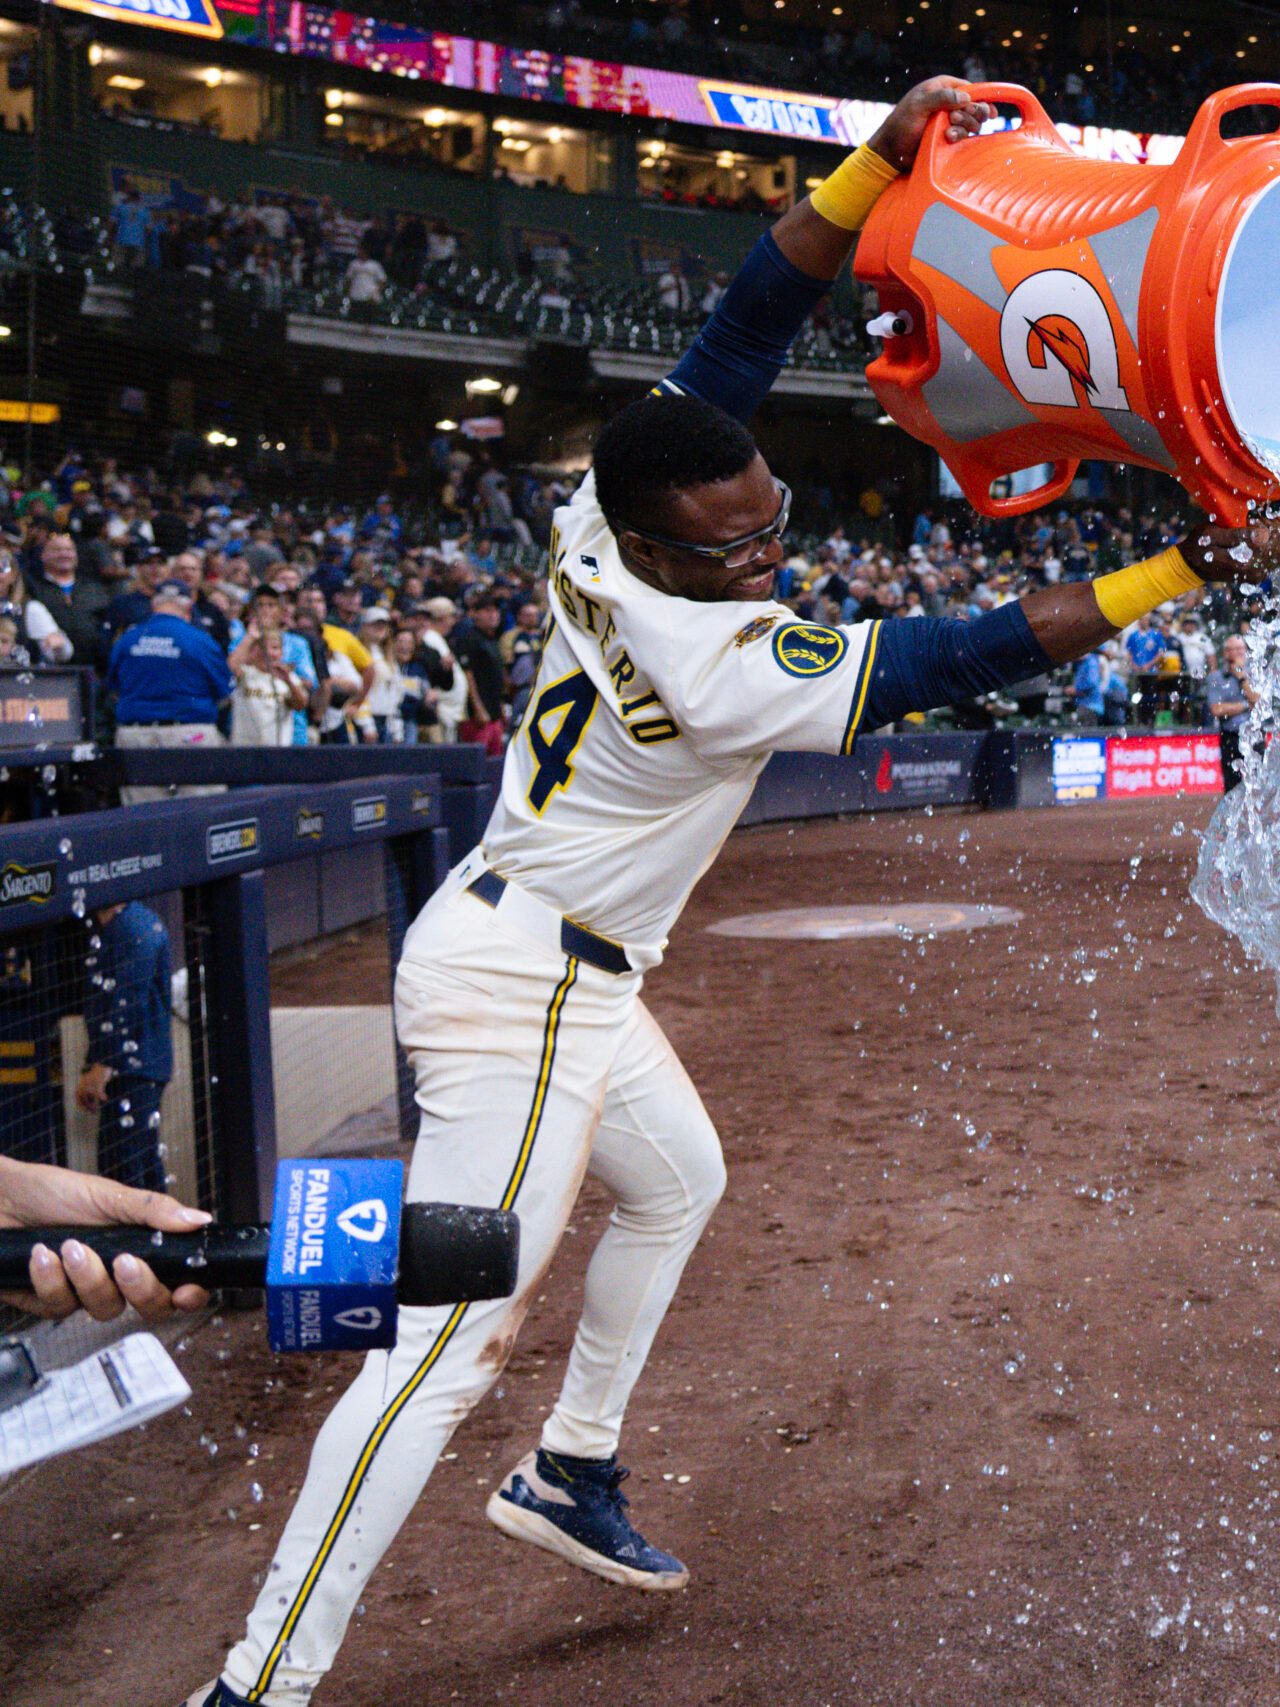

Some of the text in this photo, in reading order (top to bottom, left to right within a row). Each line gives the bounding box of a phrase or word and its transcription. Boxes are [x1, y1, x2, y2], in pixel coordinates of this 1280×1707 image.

[730, 94, 821, 137] WIN
[1112, 747, 1156, 767] Home
[1159, 744, 1192, 764] Run
[1112, 769, 1152, 791] Right
[1156, 766, 1183, 787] Off
[1187, 765, 1217, 785] The
[88, 863, 110, 883] REAL
[110, 855, 141, 878] CHEESE
[281, 1168, 304, 1275] SPORTS NETWORK
[299, 1168, 330, 1275] FANDUEL
[299, 1289, 321, 1347] FANDUEL
